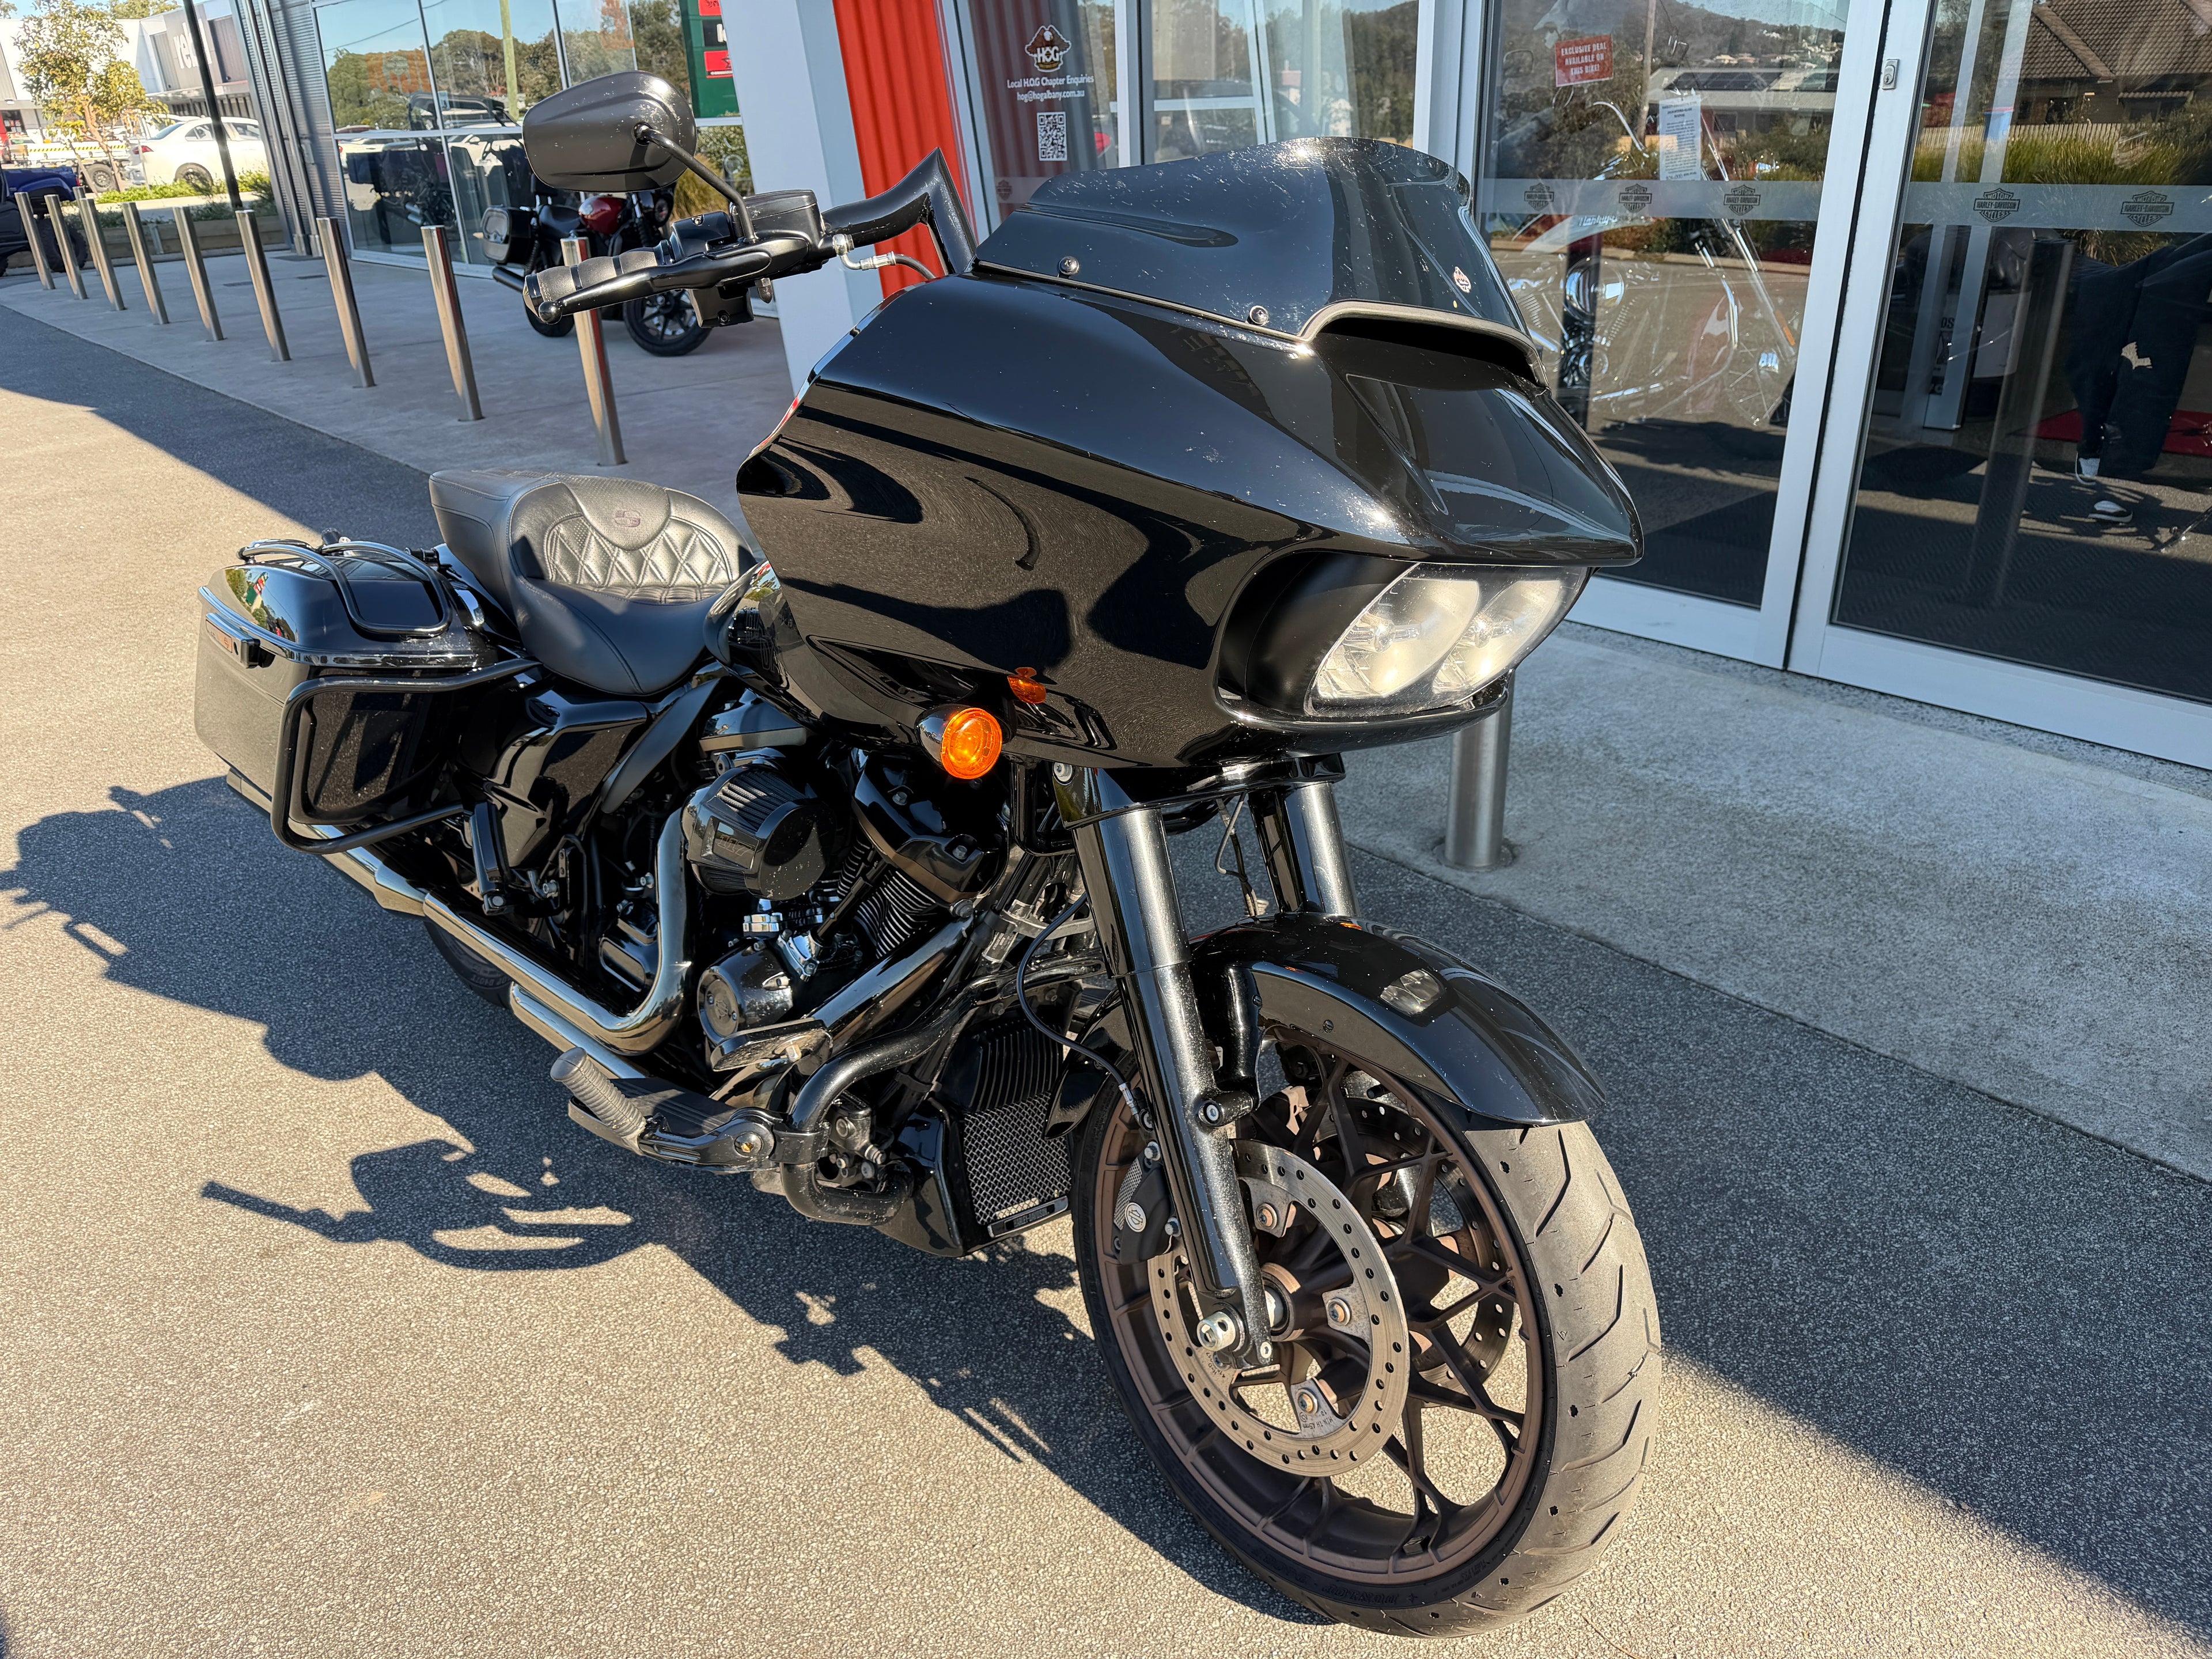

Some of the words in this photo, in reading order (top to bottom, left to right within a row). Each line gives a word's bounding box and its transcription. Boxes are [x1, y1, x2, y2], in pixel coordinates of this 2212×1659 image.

[1037, 46, 1059, 63] HOG
[1561, 44, 1590, 56] EXCLUSIVE
[1593, 42, 1607, 51] DEAL
[1565, 54, 1594, 65] AVAILABLE
[1596, 53, 1604, 61] ON
[1571, 66, 1583, 75] THIS
[1007, 79, 1022, 88] Local
[1041, 76, 1065, 88] Chapter
[1066, 74, 1094, 86] Enquiries
[1976, 200, 2017, 209] HARLEY-DAVIDSON
[2124, 204, 2170, 213] HARLEY-DAVIDSON
